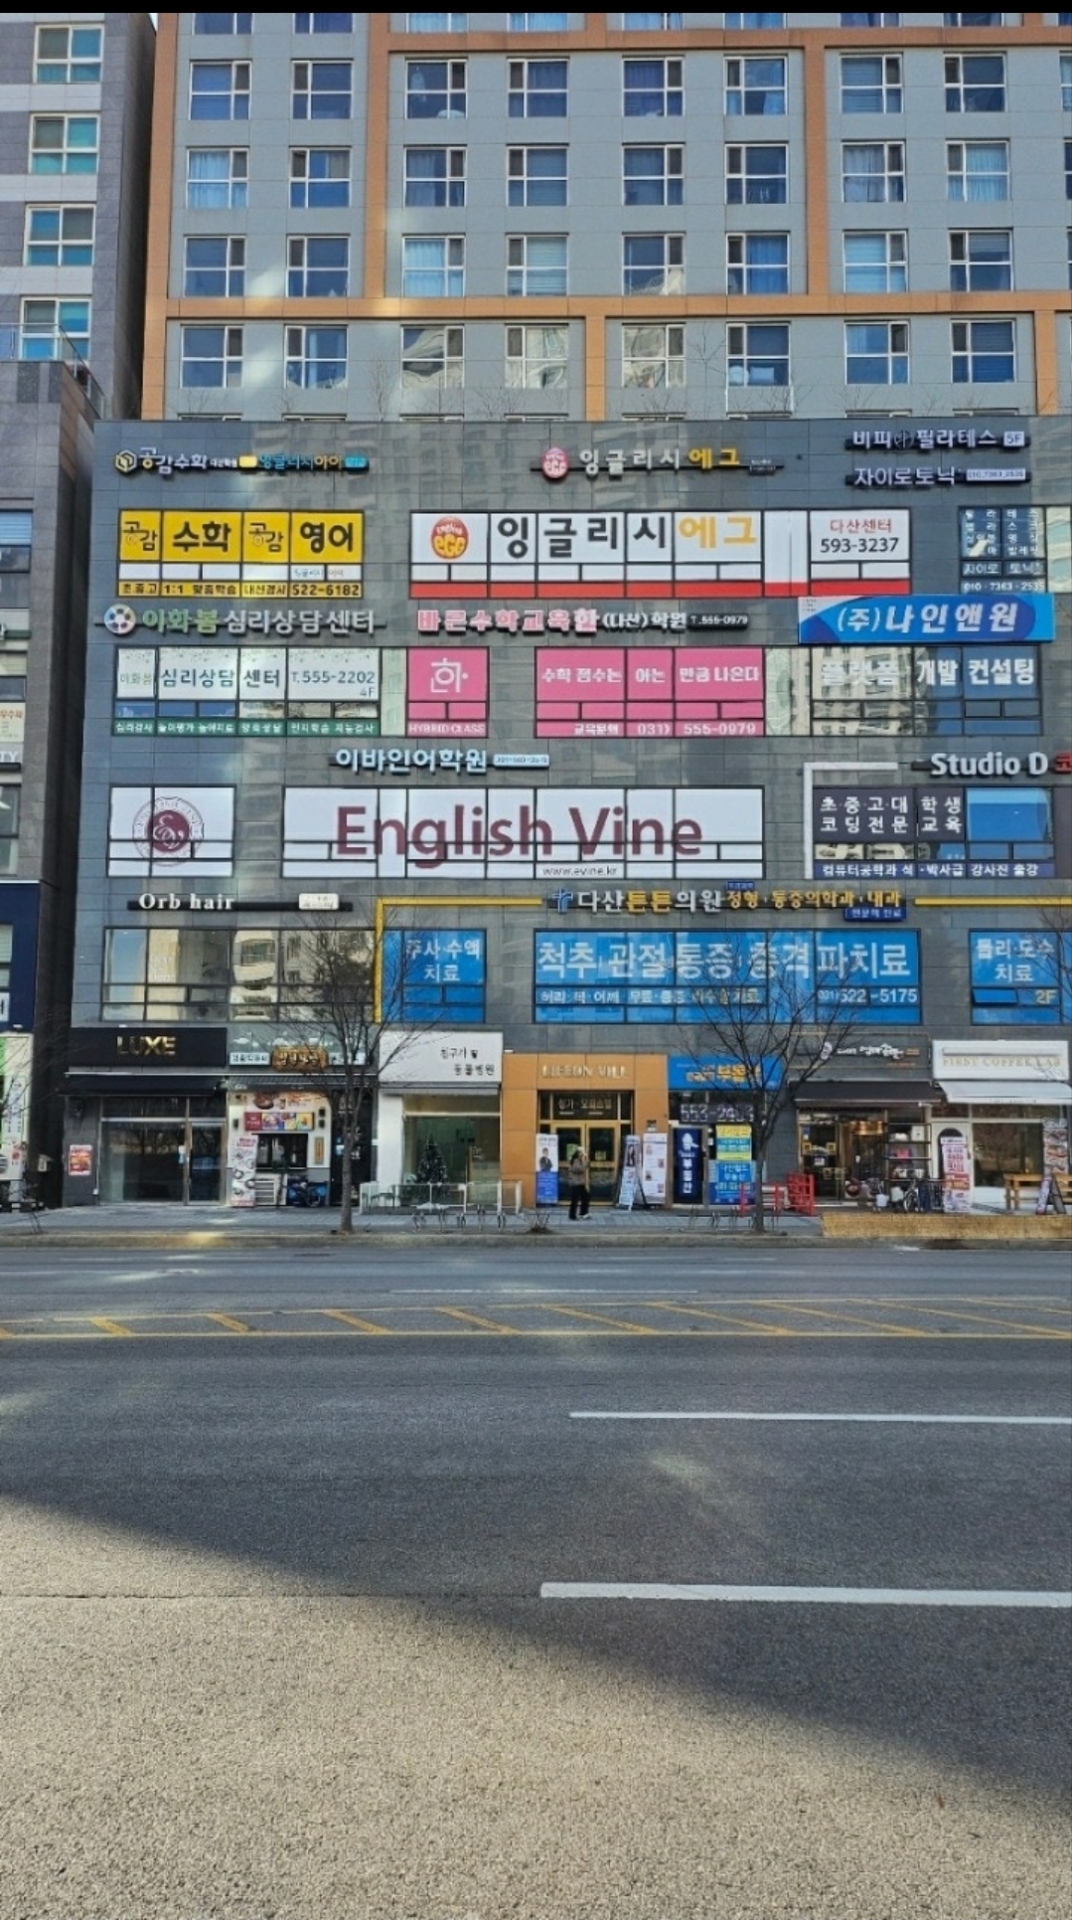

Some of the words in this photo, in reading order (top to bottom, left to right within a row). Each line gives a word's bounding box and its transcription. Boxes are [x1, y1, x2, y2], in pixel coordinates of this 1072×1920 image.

[916, 429, 997, 449] 필라테스
[1006, 433, 1022, 445] 5F
[854, 467, 955, 486] 자이로토닉
[829, 518, 892, 534] 다산센터
[173, 521, 232, 552] 수학
[300, 521, 353, 554] 영어
[820, 537, 899, 554] 593-3237
[164, 584, 184, 595] 1:1
[292, 584, 360, 595] 522-6182
[143, 607, 219, 634] 이화봄
[224, 608, 375, 635] 심리상담센터
[160, 667, 235, 688] 심리상담
[243, 668, 281, 688] 센터
[291, 671, 375, 685] T.555-2202
[543, 667, 572, 683] 수학
[576, 666, 623, 683] 점수는
[635, 667, 666, 683] 아는
[679, 666, 711, 683] 만큼
[713, 665, 760, 683] 나온다
[821, 660, 900, 686] 플랫폼
[916, 658, 958, 686] 개발
[969, 658, 1035, 686] 컨설팅
[360, 686, 375, 697] 4F
[408, 723, 448, 735] HYBRID
[452, 723, 486, 735] CLASS
[683, 723, 757, 735] 555-0979
[335, 748, 487, 773] 이바인어학원
[930, 752, 1020, 776] Studio
[1029, 752, 1049, 775] D
[336, 804, 552, 868] English
[568, 806, 704, 855] Vine
[823, 863, 897, 876] 컴퓨터공학과
[971, 863, 1009, 877] 강사진
[138, 893, 181, 910] Orb
[190, 893, 235, 910] hair
[577, 889, 722, 914] 다산튼튼의원
[423, 964, 461, 983] 치료
[994, 964, 1034, 983] 치료
[1035, 990, 1057, 1004] 2F
[117, 1036, 177, 1056] LUXE
[454, 1062, 495, 1076] 동물병원
[942, 1057, 976, 1067] FIRST
[982, 1057, 1032, 1067] COFFEE
[1035, 1057, 1061, 1067] LAB
